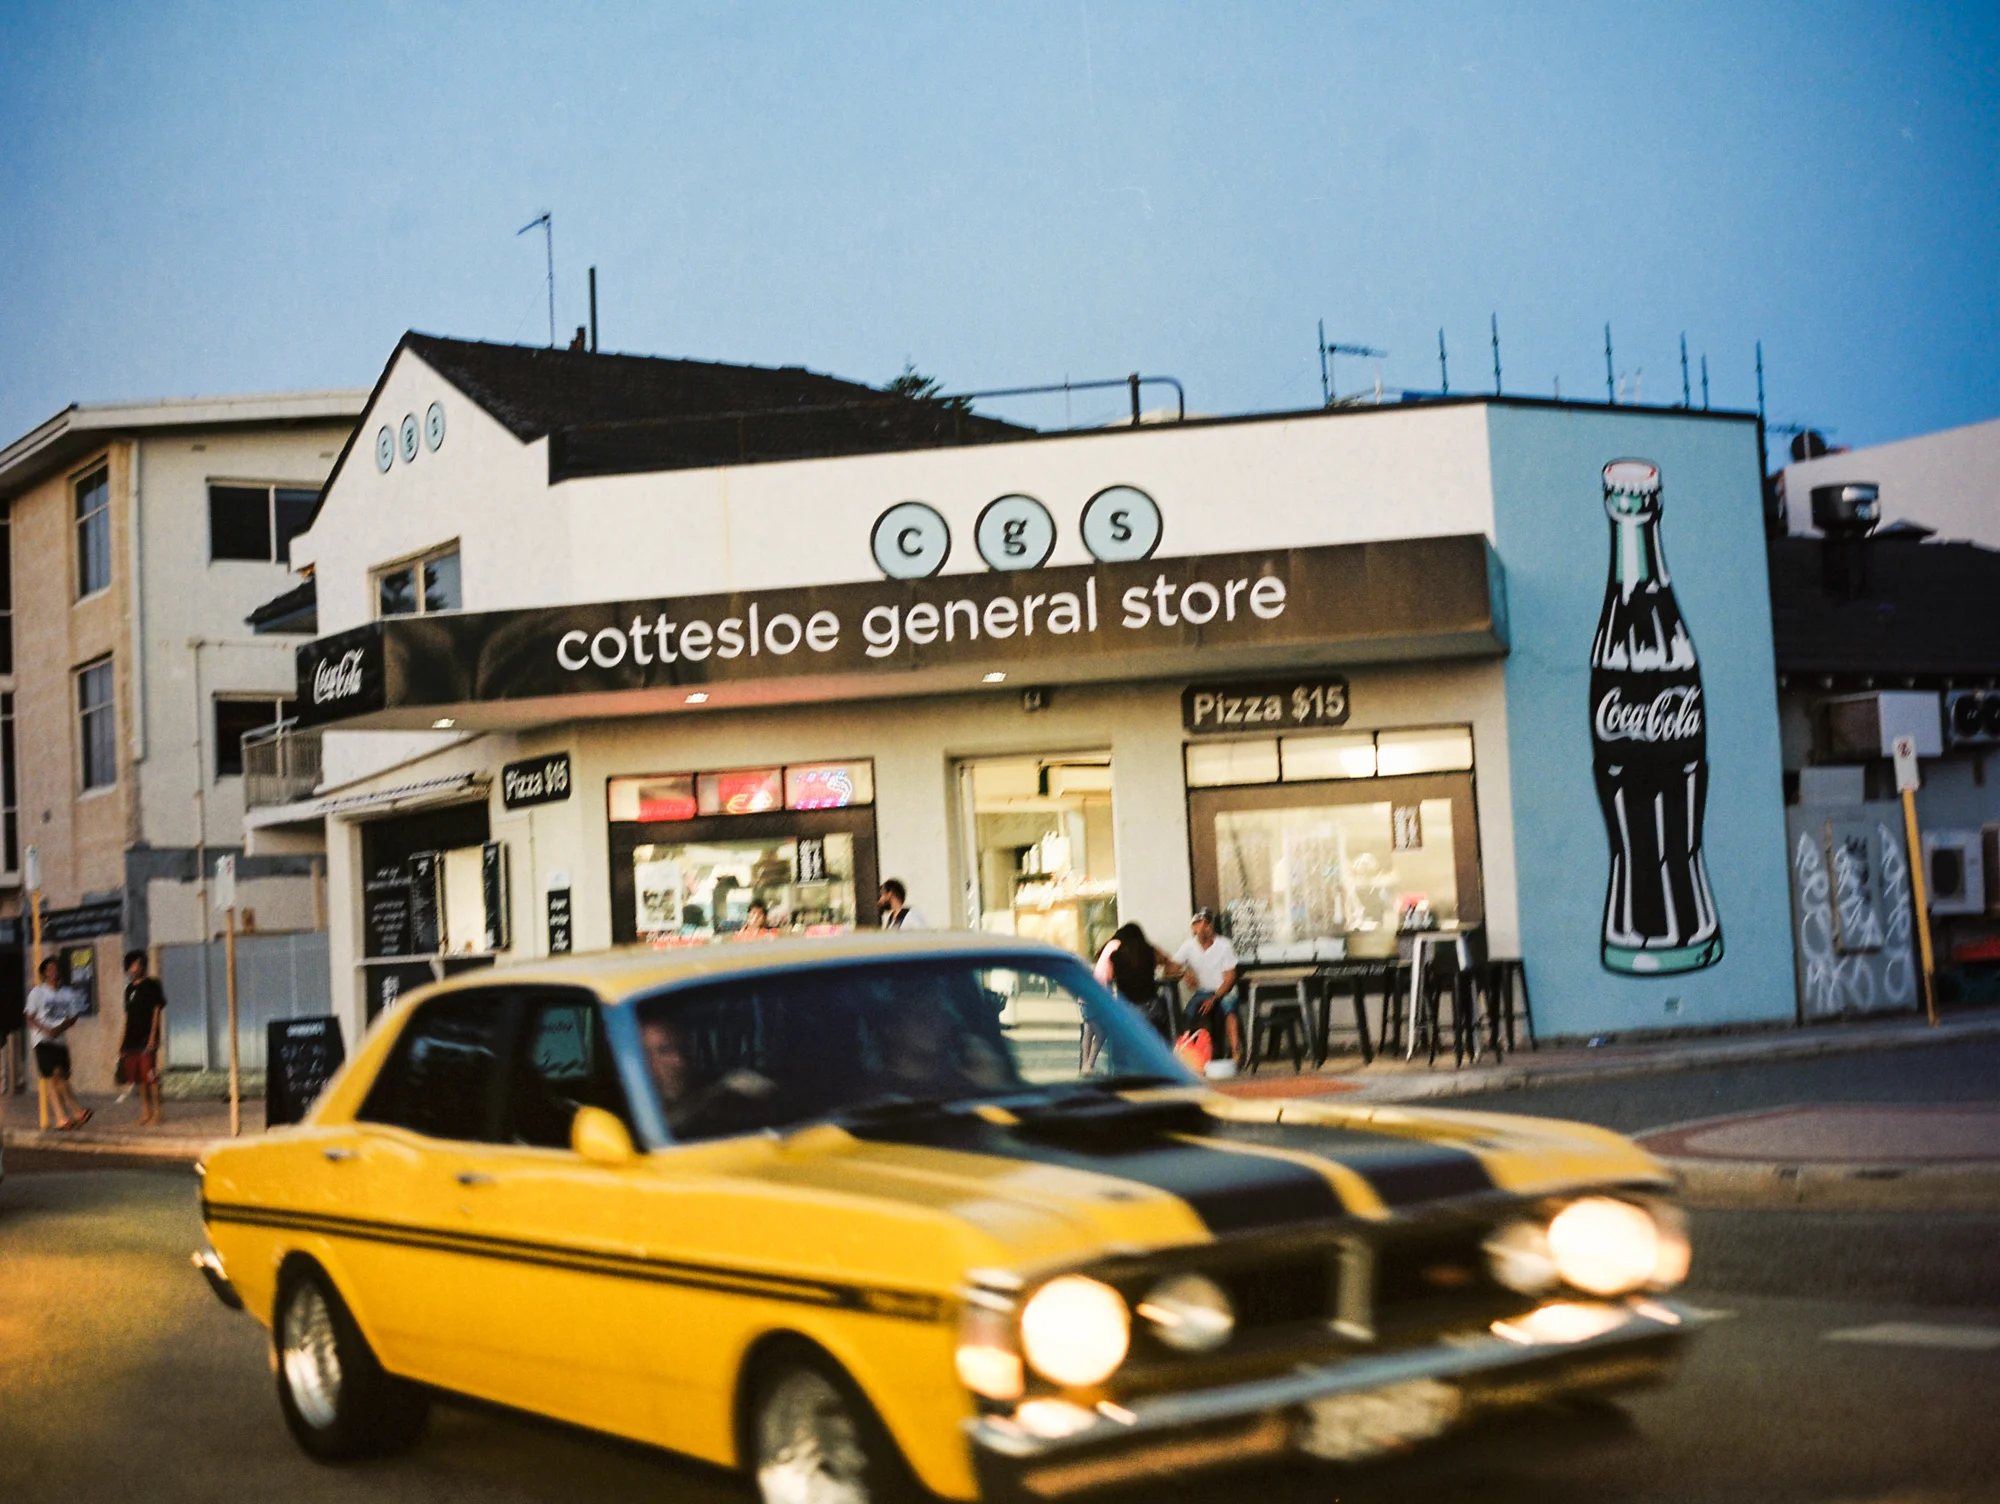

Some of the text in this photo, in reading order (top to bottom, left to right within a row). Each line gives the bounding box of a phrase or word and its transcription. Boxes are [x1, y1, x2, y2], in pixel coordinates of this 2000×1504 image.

[897, 511, 1132, 557] c g s
[556, 574, 1286, 671] cottesloe general store
[1193, 685, 1345, 726] Pizza $15
[1595, 684, 1701, 743] Coca-Cola
[505, 760, 568, 801] Pizza $15
